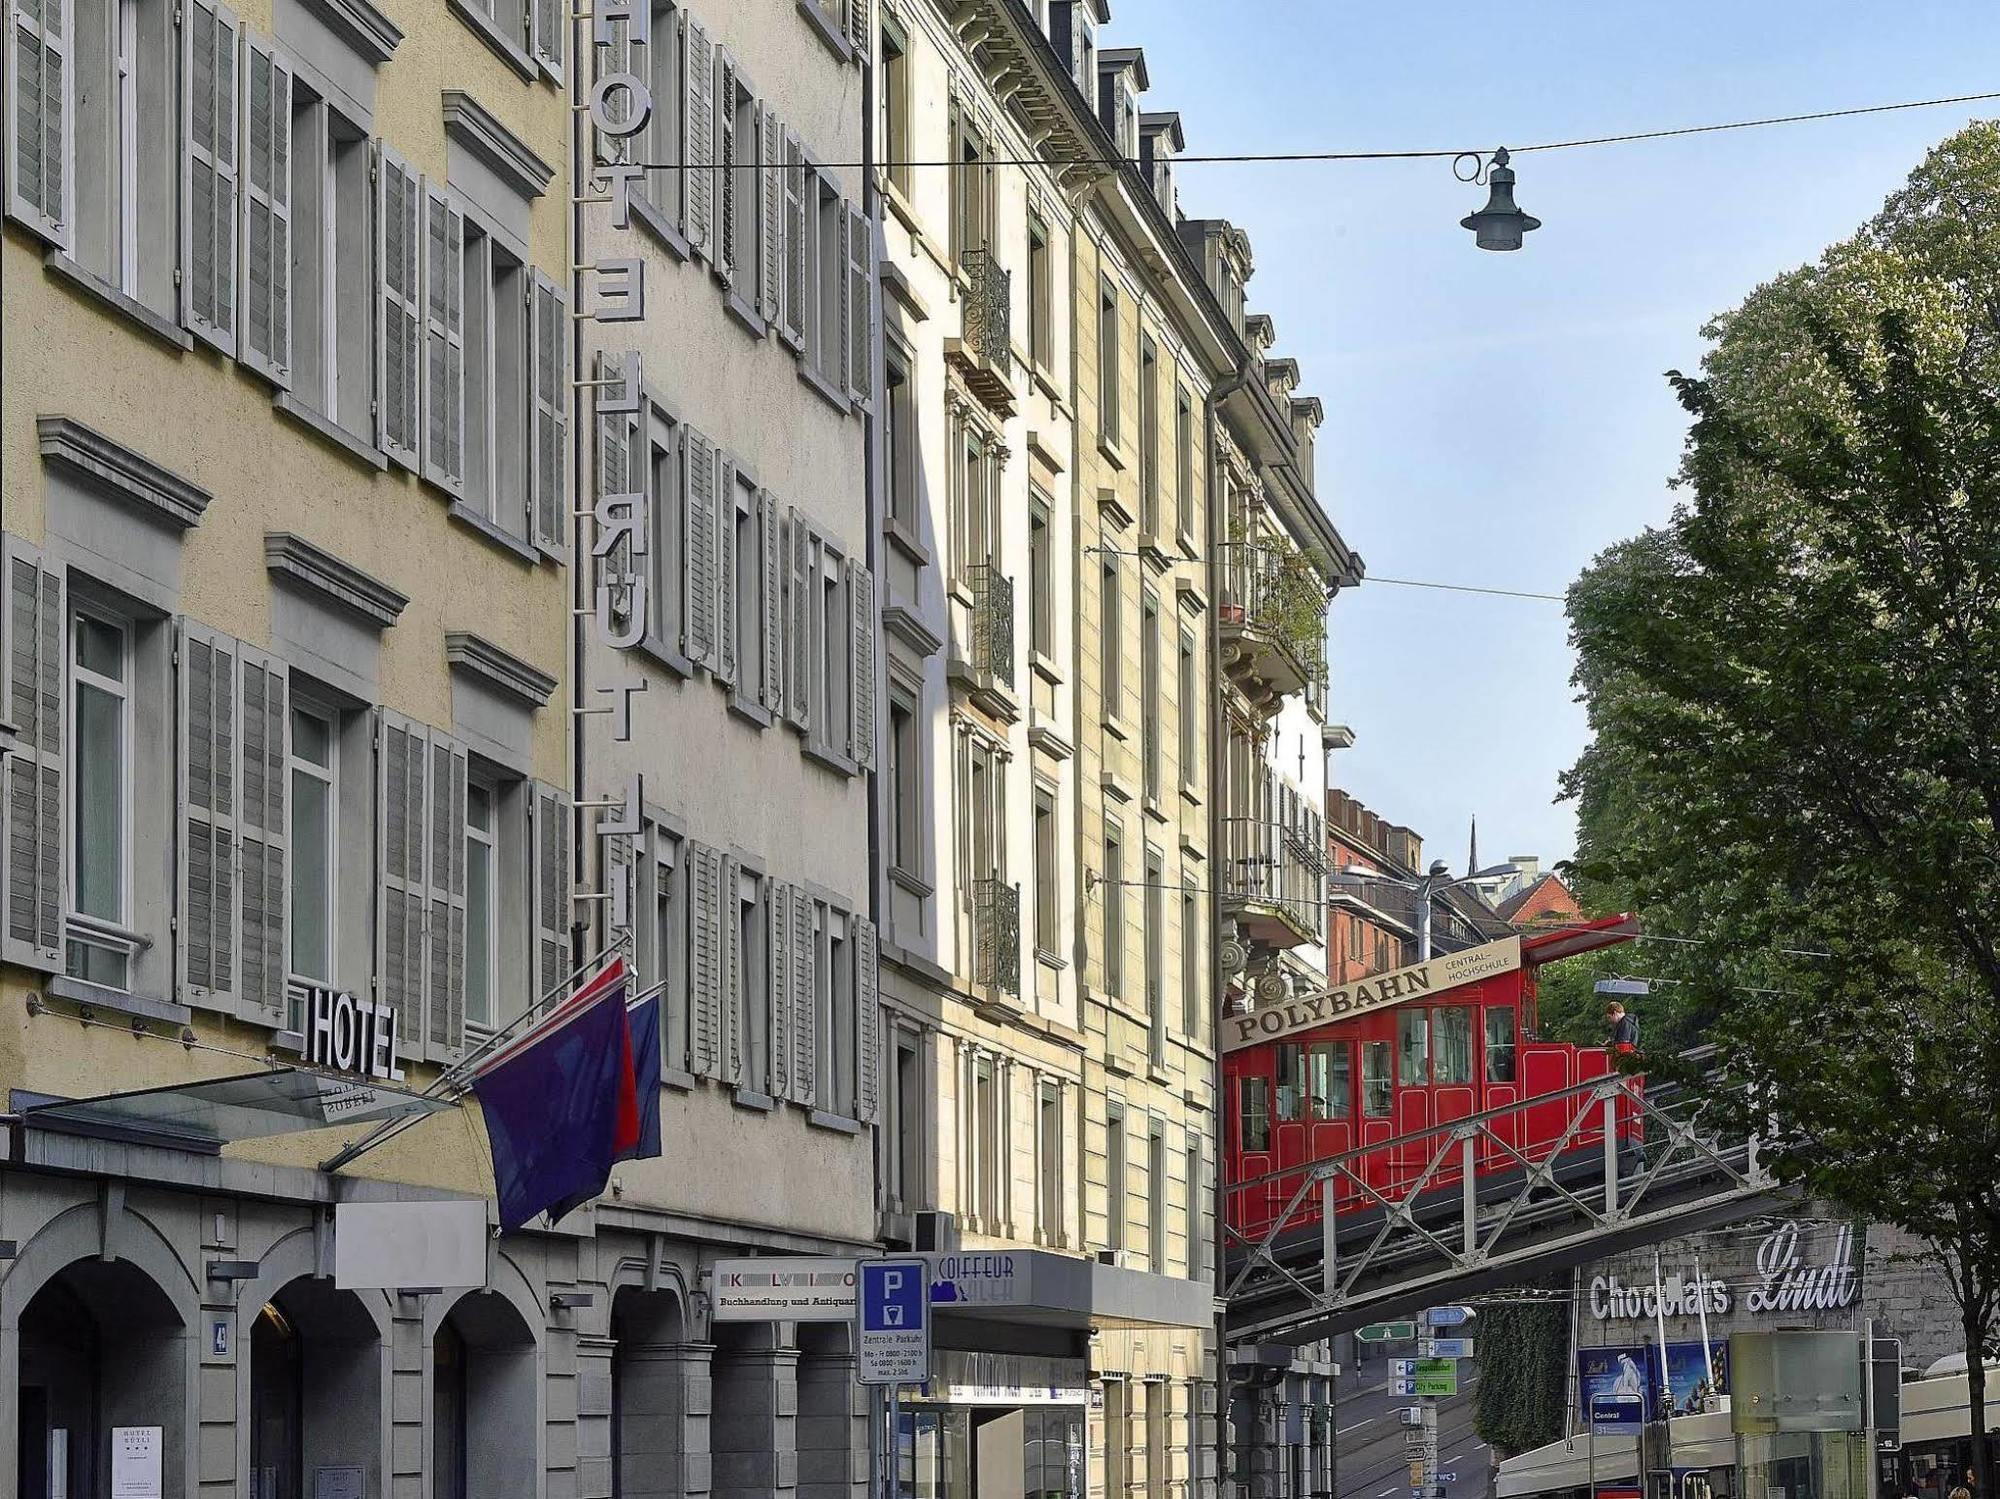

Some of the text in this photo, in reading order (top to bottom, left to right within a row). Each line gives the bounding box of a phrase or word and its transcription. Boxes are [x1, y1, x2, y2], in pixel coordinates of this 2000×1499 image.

[1448, 957, 1509, 982] HOCHSCHULE
[1235, 967, 1430, 1041] POLYBAHN
[314, 988, 405, 1081] HOTEL
[939, 1256, 1013, 1279] COIFFEUR
[1746, 1220, 1856, 1312] Lindt
[884, 1271, 903, 1299] P
[720, 1298, 788, 1307] Buchhandlung
[791, 1298, 809, 1306] und
[216, 1327, 226, 1350] 4
[864, 1334, 893, 1344] Zentrale
